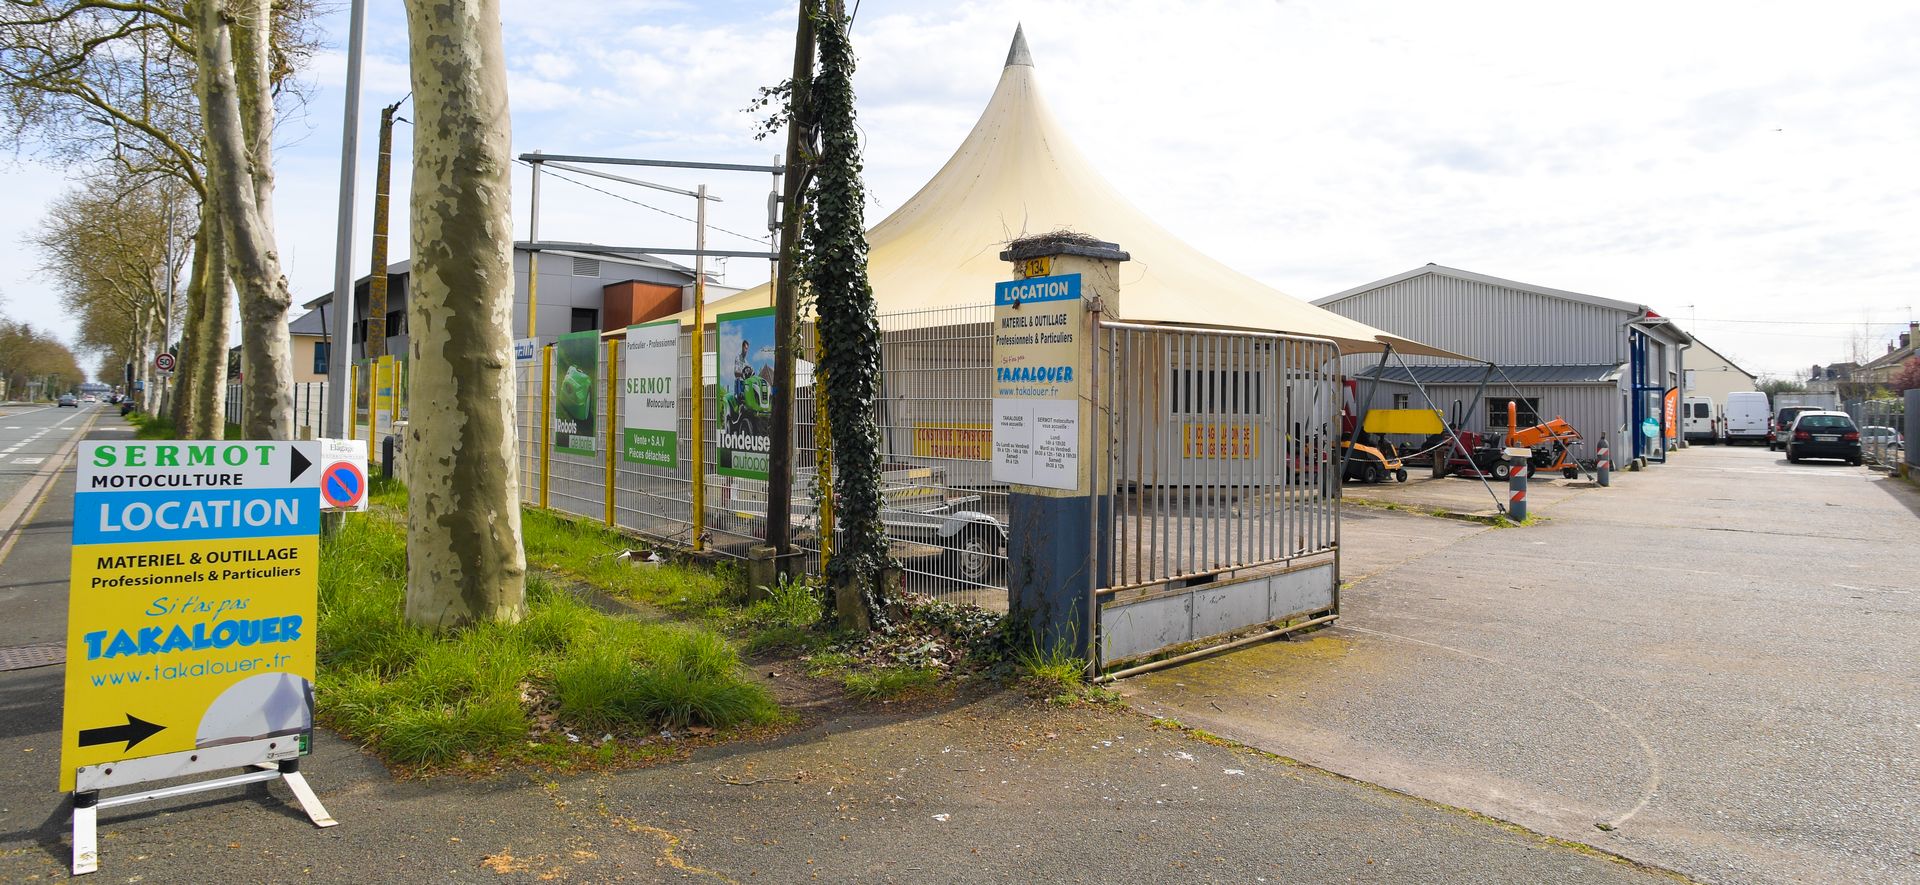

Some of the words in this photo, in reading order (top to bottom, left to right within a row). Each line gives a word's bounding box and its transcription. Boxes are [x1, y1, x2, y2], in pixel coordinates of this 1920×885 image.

[1030, 260, 1044, 274] 134
[1004, 281, 1069, 301] LOCATION
[1002, 316, 1028, 329] MATERIEL
[1029, 316, 1033, 327] &
[1034, 314, 1067, 326] OUTILLAGE
[627, 341, 646, 350] Particulier
[649, 338, 677, 348] Professionnel
[996, 333, 1033, 346] Professionnels
[1034, 333, 1039, 344] &
[1040, 331, 1073, 344] Particuliers
[160, 358, 170, 366] 50
[996, 366, 1074, 384] TAKALOUER
[626, 377, 672, 394] SERMOT
[999, 385, 1059, 397] www.takalouer.fr
[646, 398, 675, 409] Motoculture
[558, 419, 577, 434] Robots
[634, 434, 647, 445] Vente
[93, 445, 275, 467] SERMOT
[629, 447, 644, 460] Pièces
[645, 449, 671, 463] détachées
[91, 473, 243, 488] MOTOCULTURE
[100, 498, 299, 532] LOCATION
[96, 553, 185, 570] MATERIEL
[189, 552, 202, 565] &
[206, 547, 298, 564] OUTILLAGE
[91, 571, 204, 588] Professionnels
[208, 570, 219, 581] &
[222, 566, 301, 581] Particuliers
[145, 596, 179, 617] Si
[211, 598, 250, 621] pas
[83, 615, 303, 661] TAKALOUER
[91, 653, 291, 687] www.takalouer.fr
